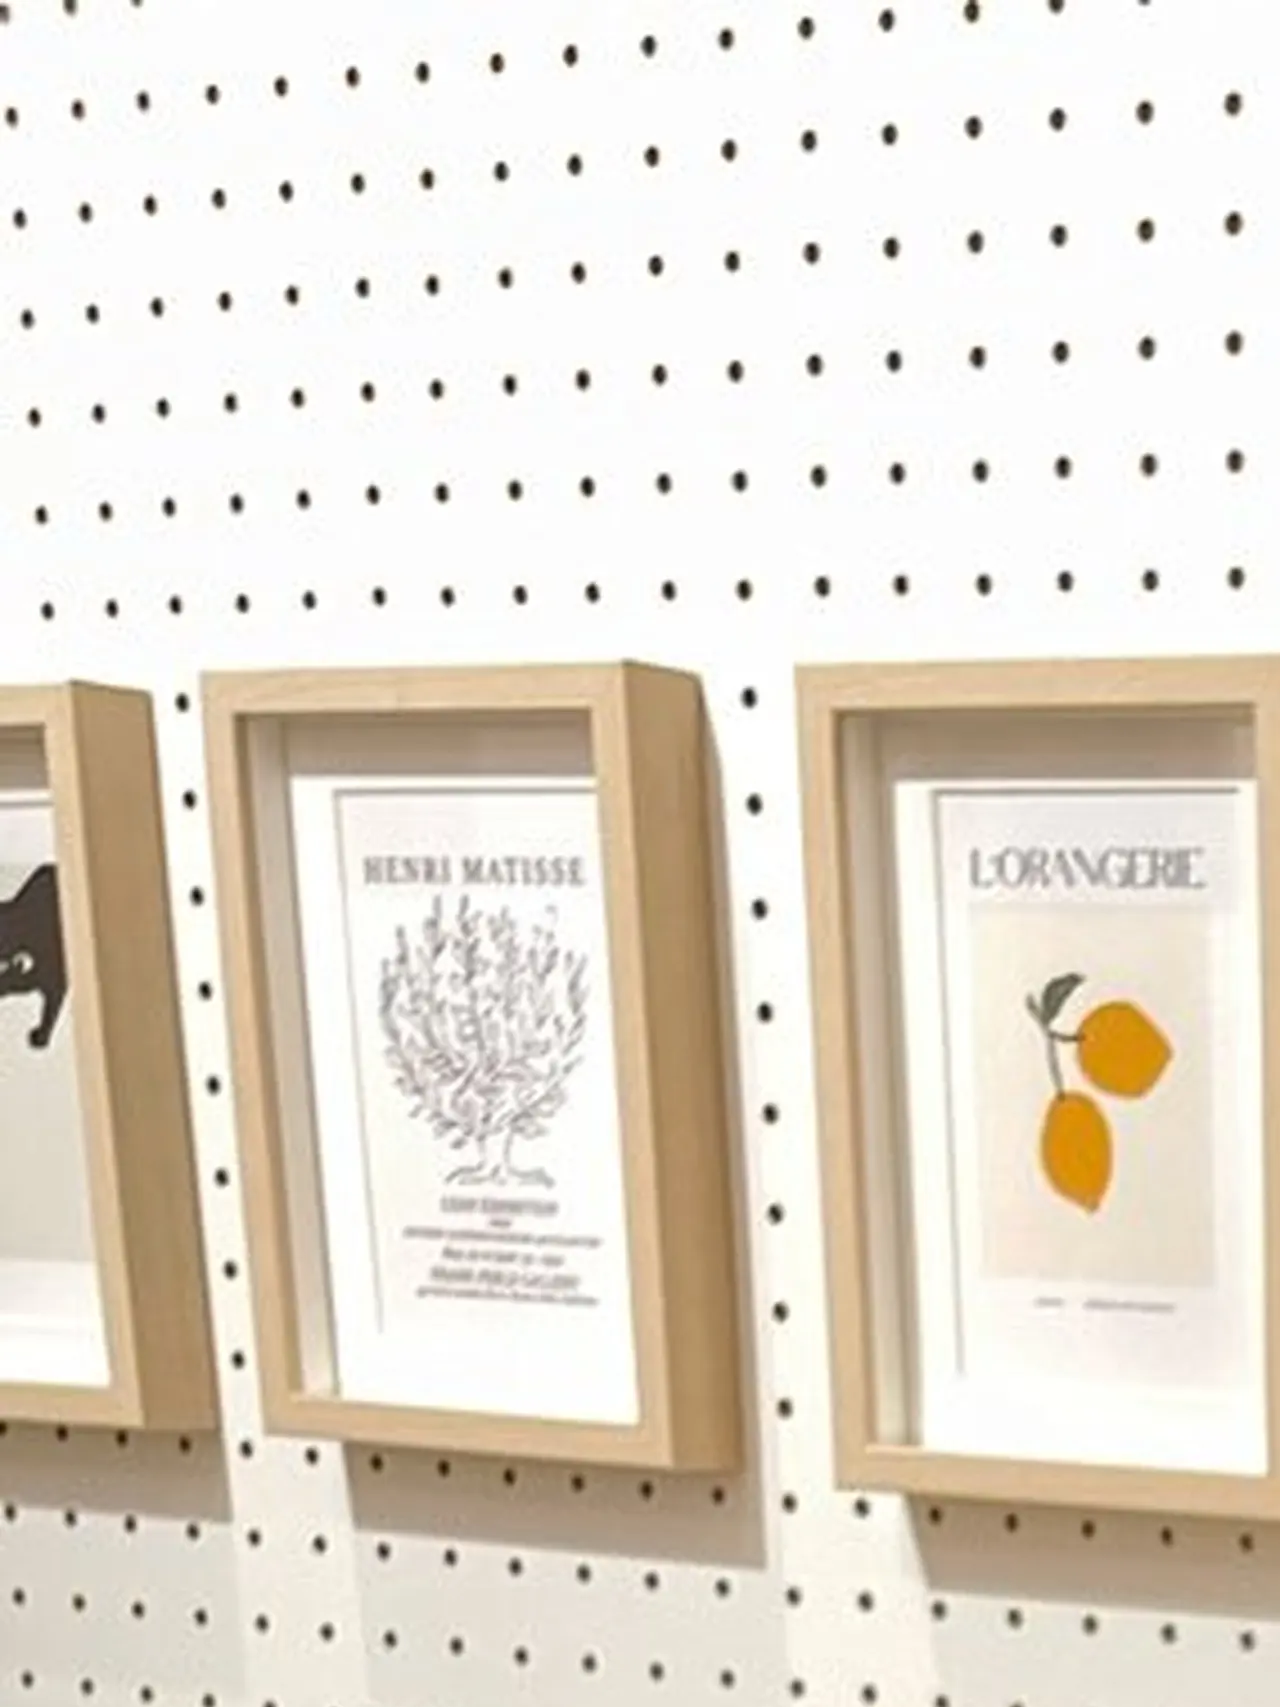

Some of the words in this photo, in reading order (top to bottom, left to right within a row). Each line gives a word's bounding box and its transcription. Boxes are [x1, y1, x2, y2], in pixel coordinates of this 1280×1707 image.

[363, 856, 452, 885] HENRI
[461, 856, 586, 887] MATISSE
[969, 846, 1208, 889] L'ORANGERIE
